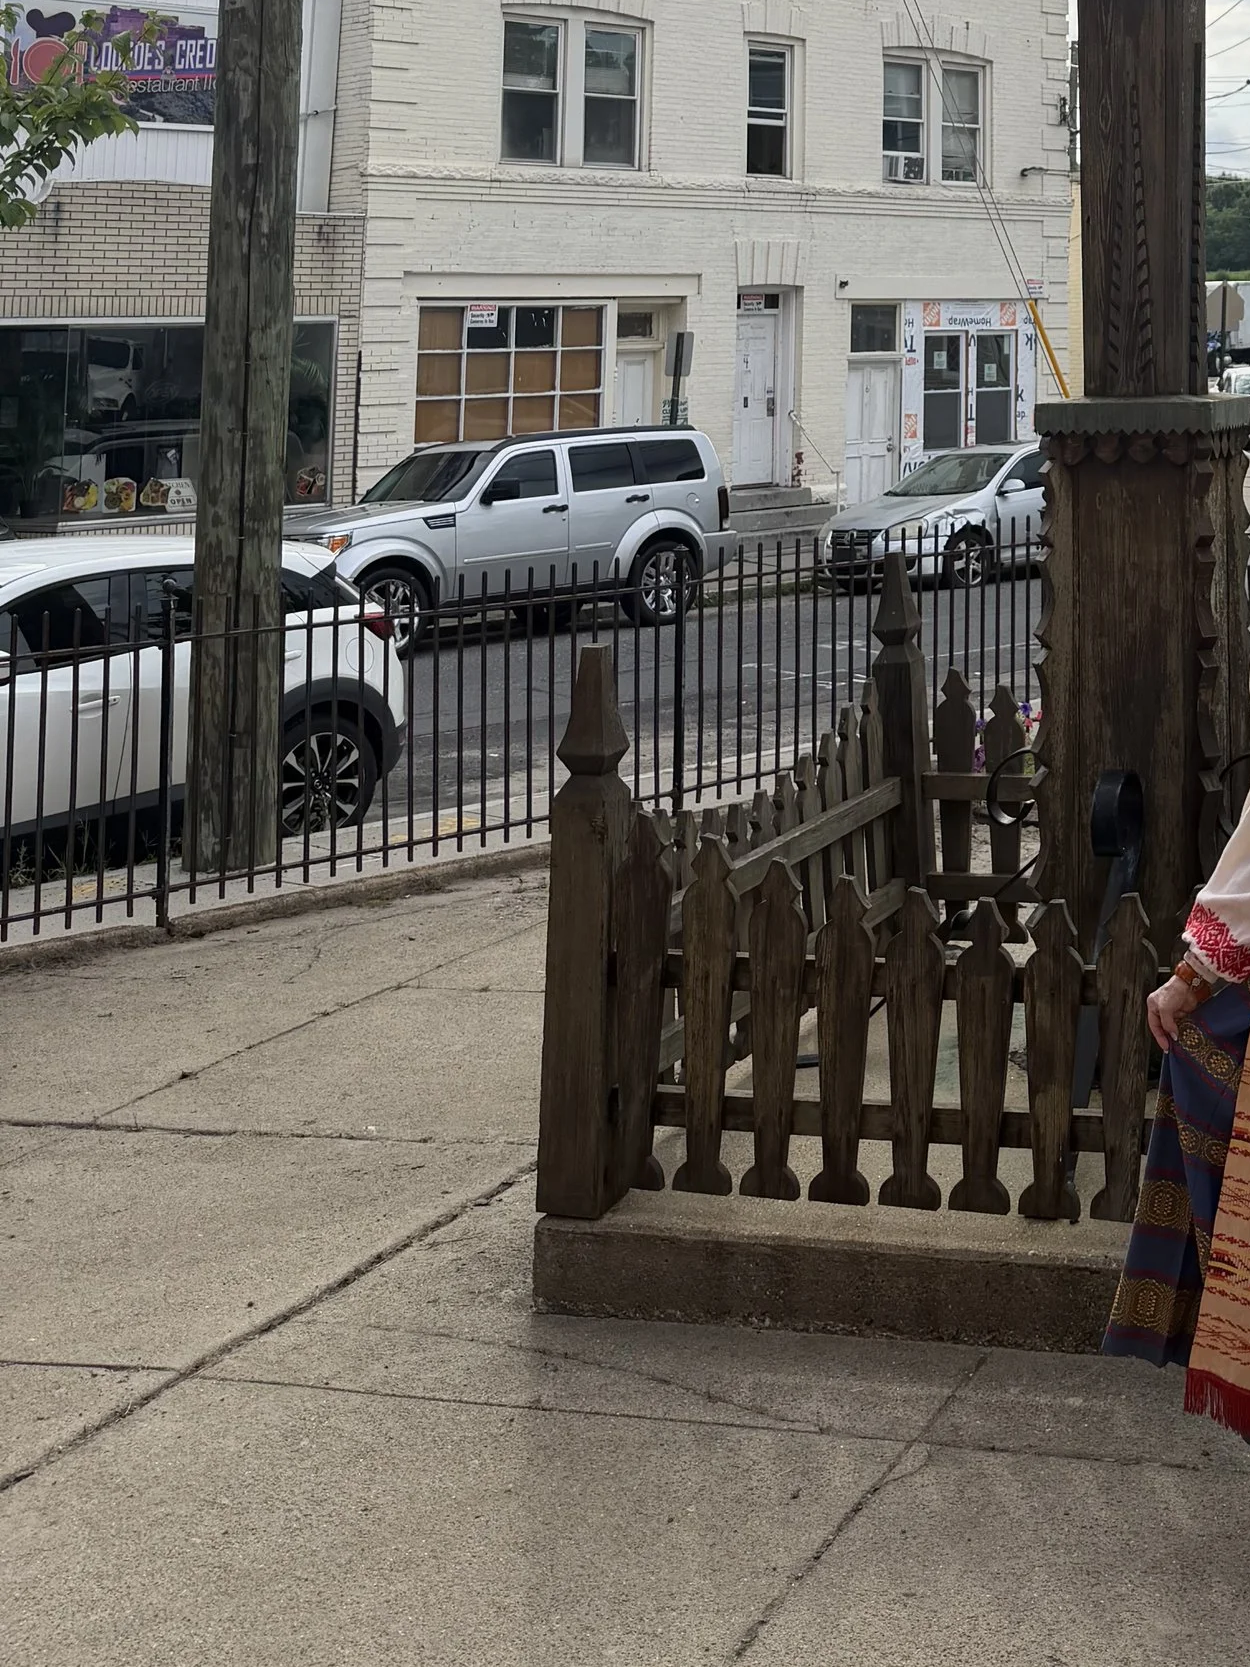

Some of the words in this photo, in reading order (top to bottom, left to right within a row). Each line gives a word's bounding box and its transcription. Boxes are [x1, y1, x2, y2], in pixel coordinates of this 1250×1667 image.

[90, 40, 165, 72] LOUDES
[174, 39, 217, 70] CREO
[126, 76, 200, 94] estaurant
